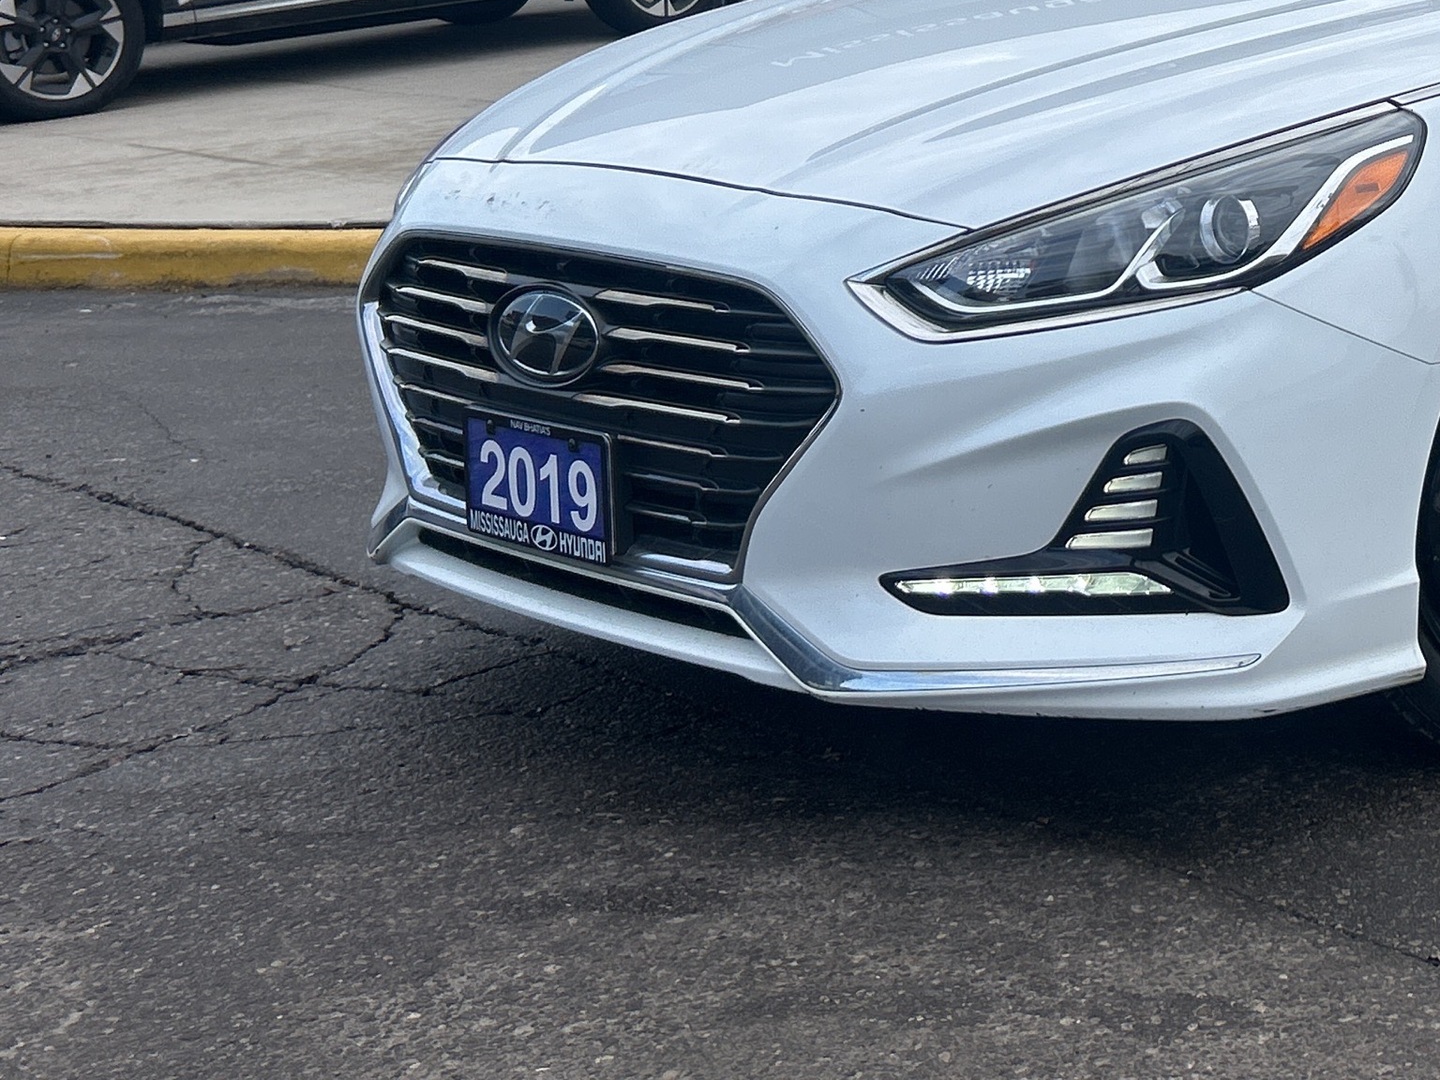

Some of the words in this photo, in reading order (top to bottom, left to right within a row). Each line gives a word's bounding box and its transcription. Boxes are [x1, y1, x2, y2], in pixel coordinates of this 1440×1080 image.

[510, 419, 524, 430] NAV
[480, 439, 598, 532] 2019
[470, 508, 530, 544] MISSISSAUGA
[560, 531, 607, 563] HYUNDAI
